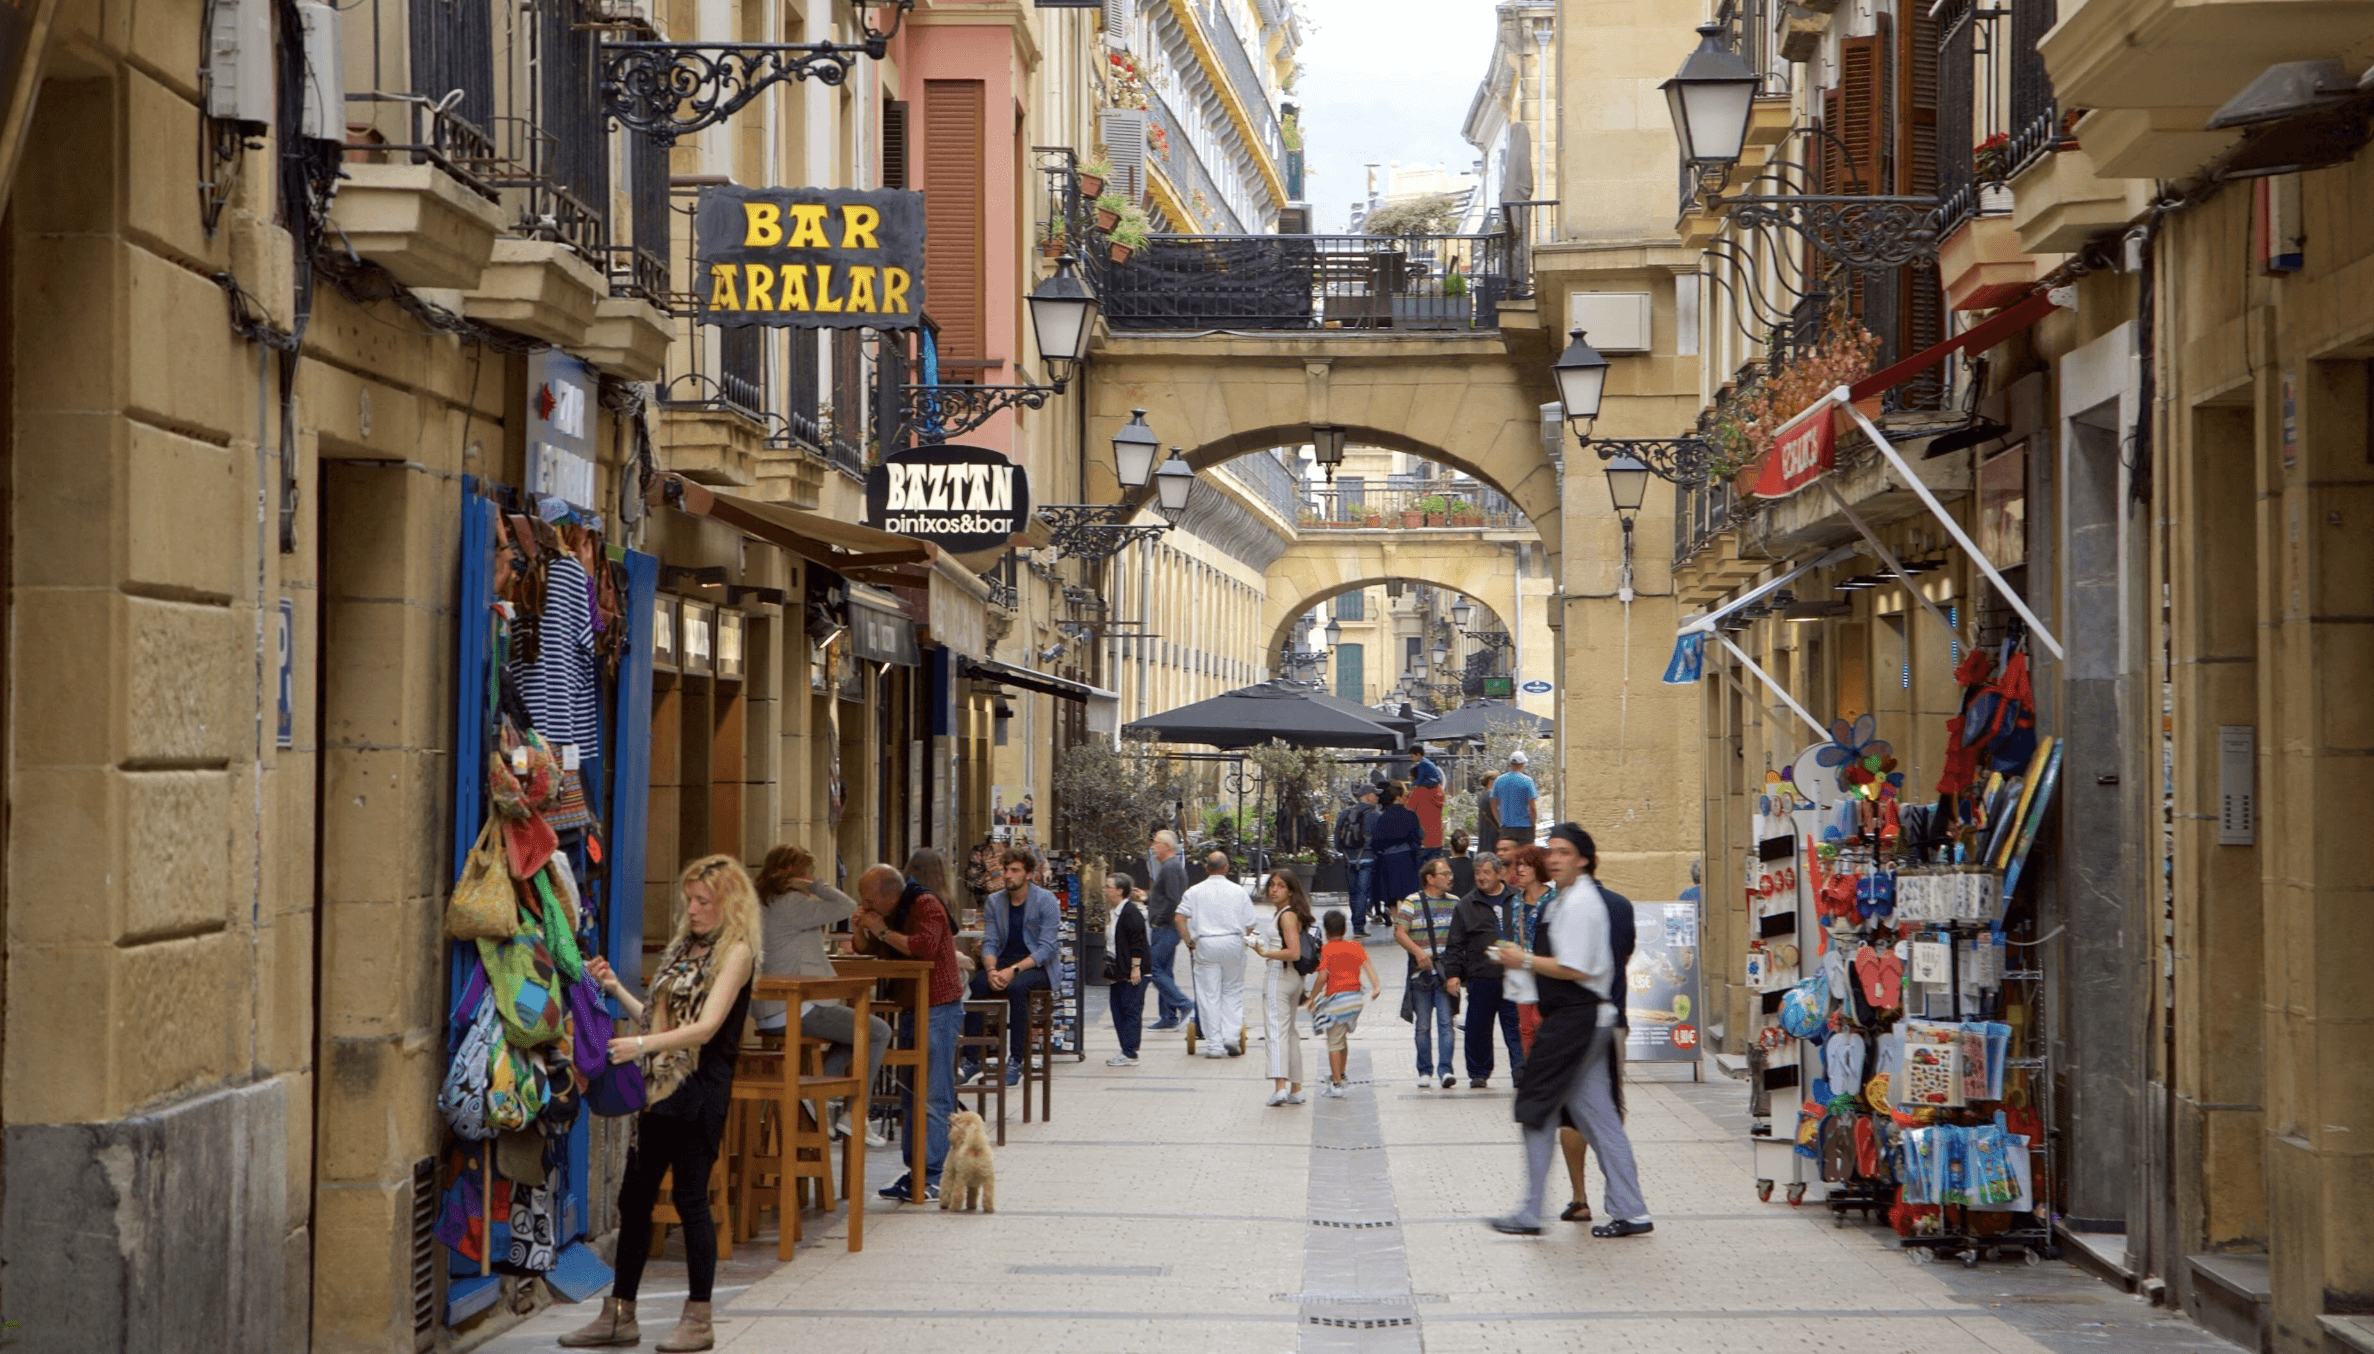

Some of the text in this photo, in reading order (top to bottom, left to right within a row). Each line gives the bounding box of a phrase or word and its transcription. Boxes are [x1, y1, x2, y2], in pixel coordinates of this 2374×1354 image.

[743, 202, 881, 249] BAR
[708, 263, 911, 314] ARALAR
[885, 462, 1014, 513] BAZTAN
[885, 513, 1014, 534] pintxos&bar
